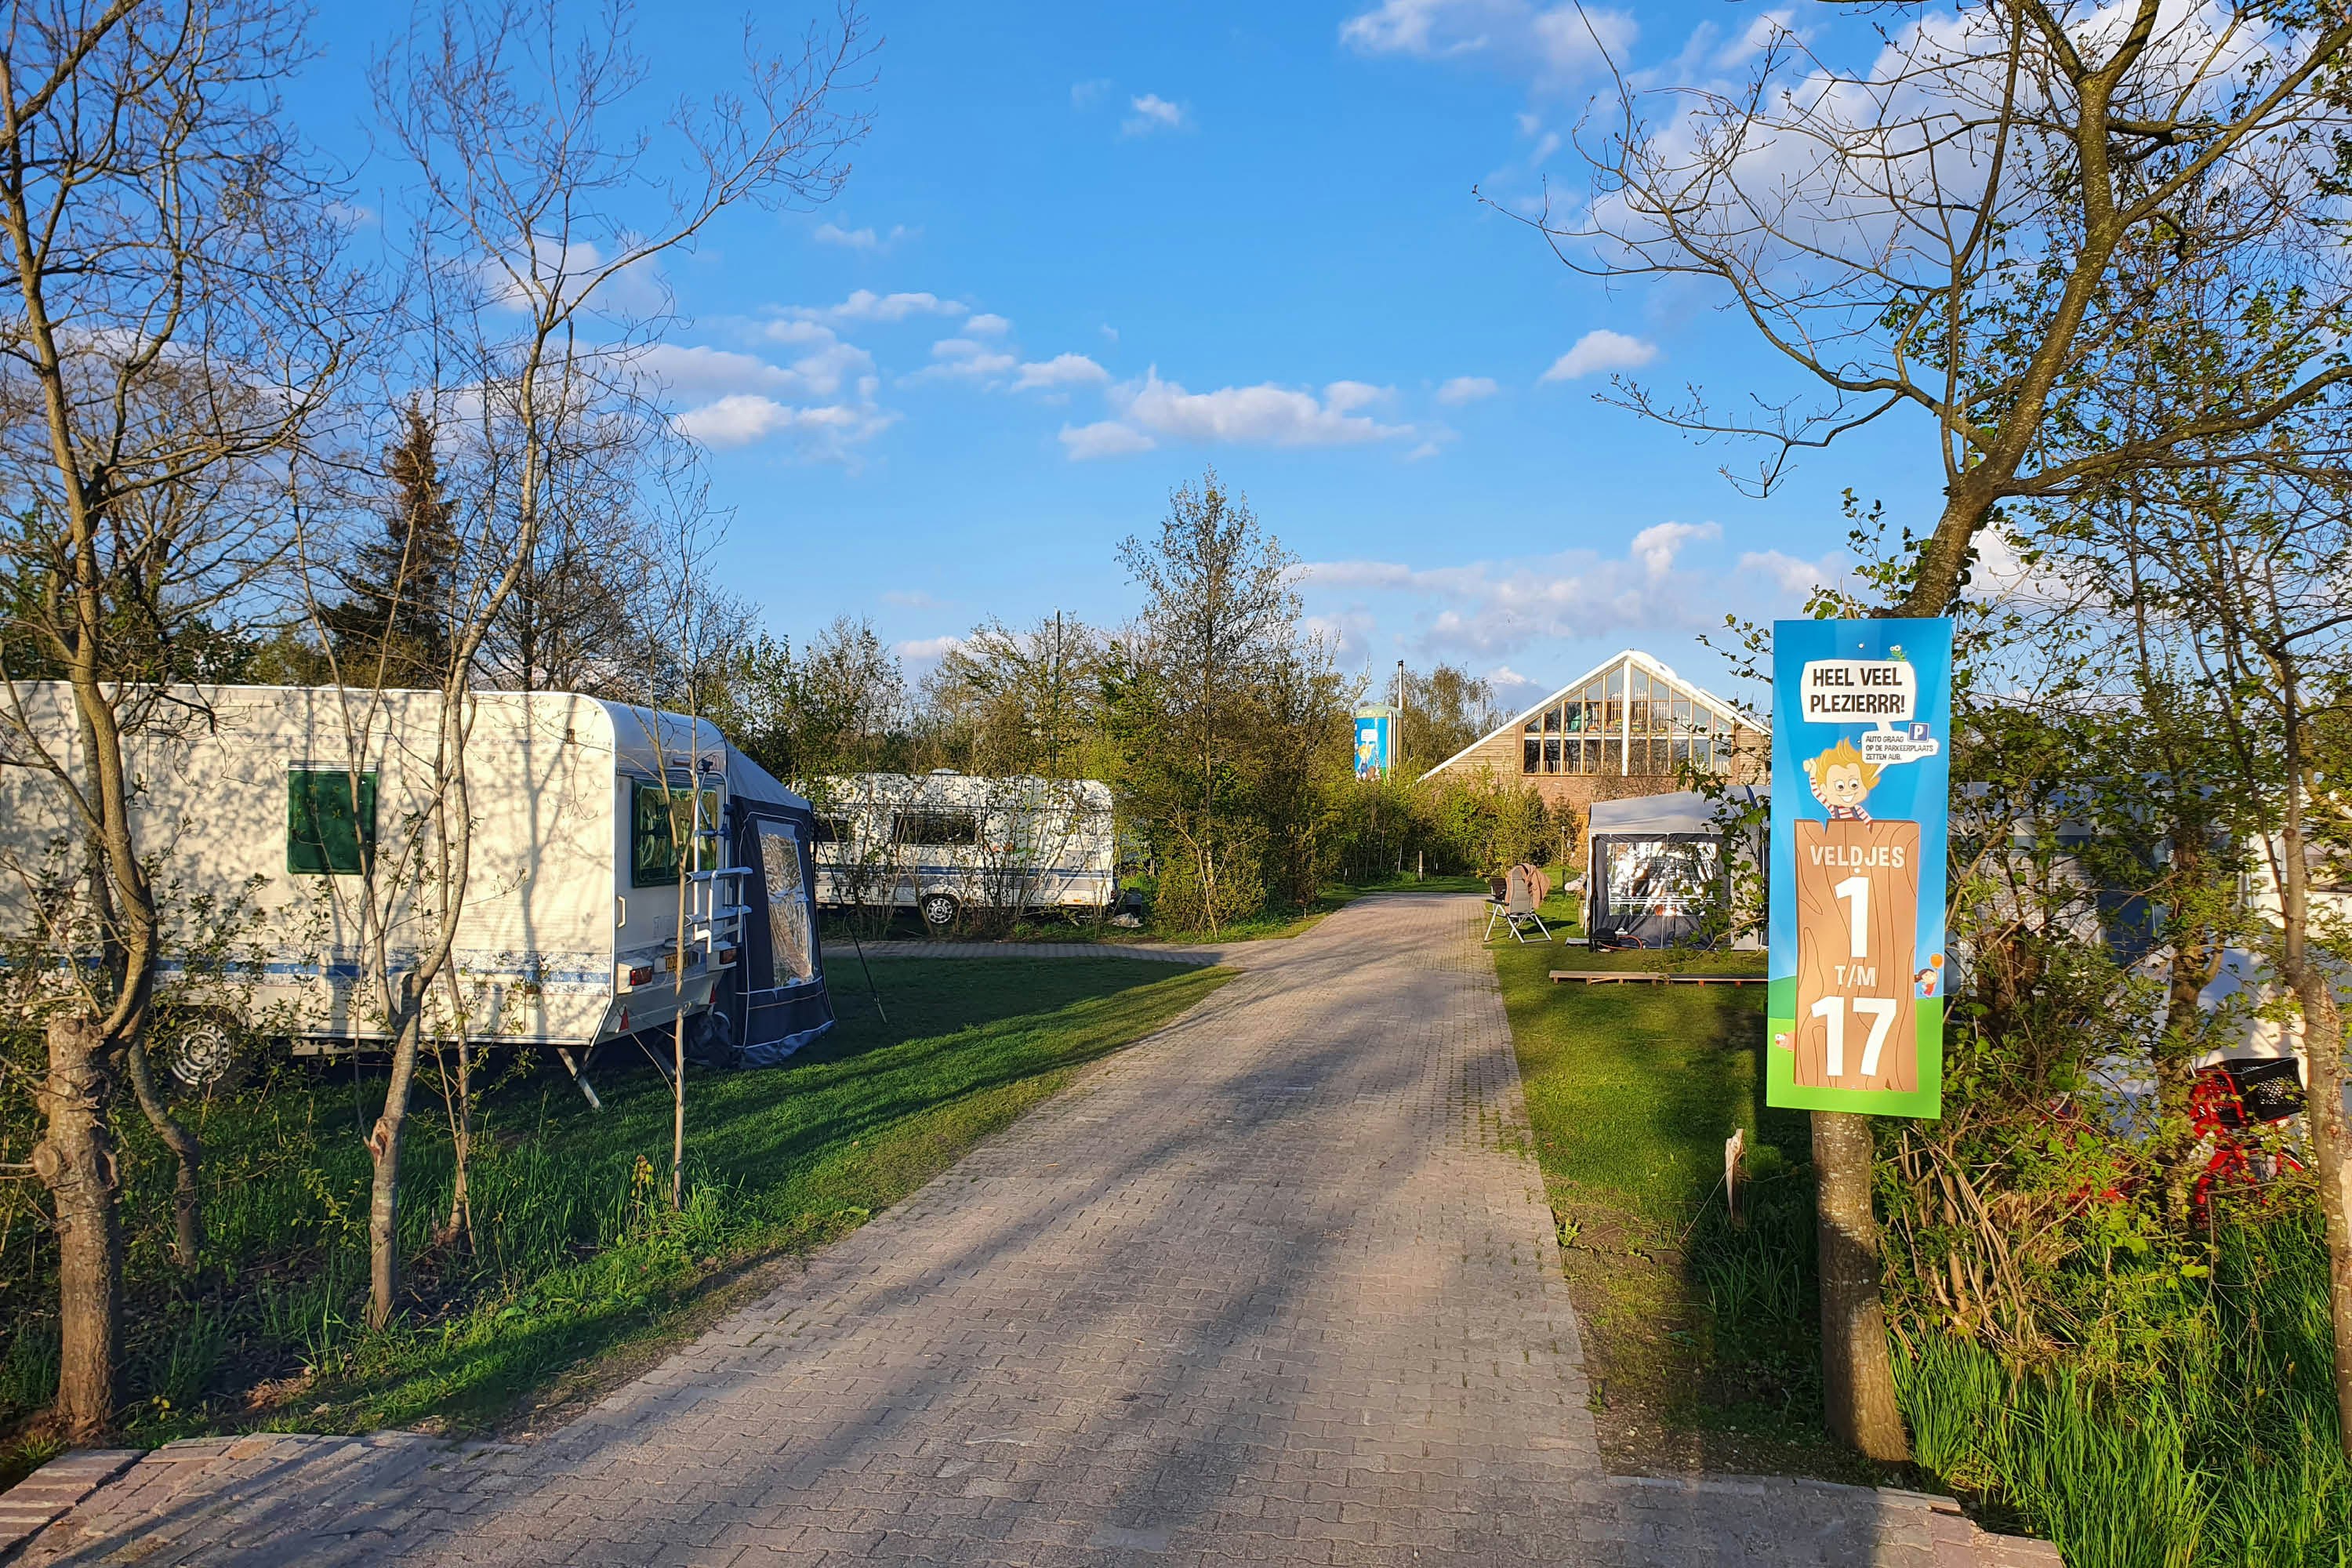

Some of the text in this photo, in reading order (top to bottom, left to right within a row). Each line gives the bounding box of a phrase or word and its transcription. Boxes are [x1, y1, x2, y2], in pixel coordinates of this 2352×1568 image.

[1813, 667, 1902, 687] HEEL VEEL
[1810, 694, 1905, 713] PLEZIERRR!
[1914, 724, 1923, 739] P
[1809, 845, 1904, 868] VELDJES
[1835, 876, 1869, 958] 1
[1835, 964, 1876, 988] T/M
[1811, 996, 1897, 1076] 17
